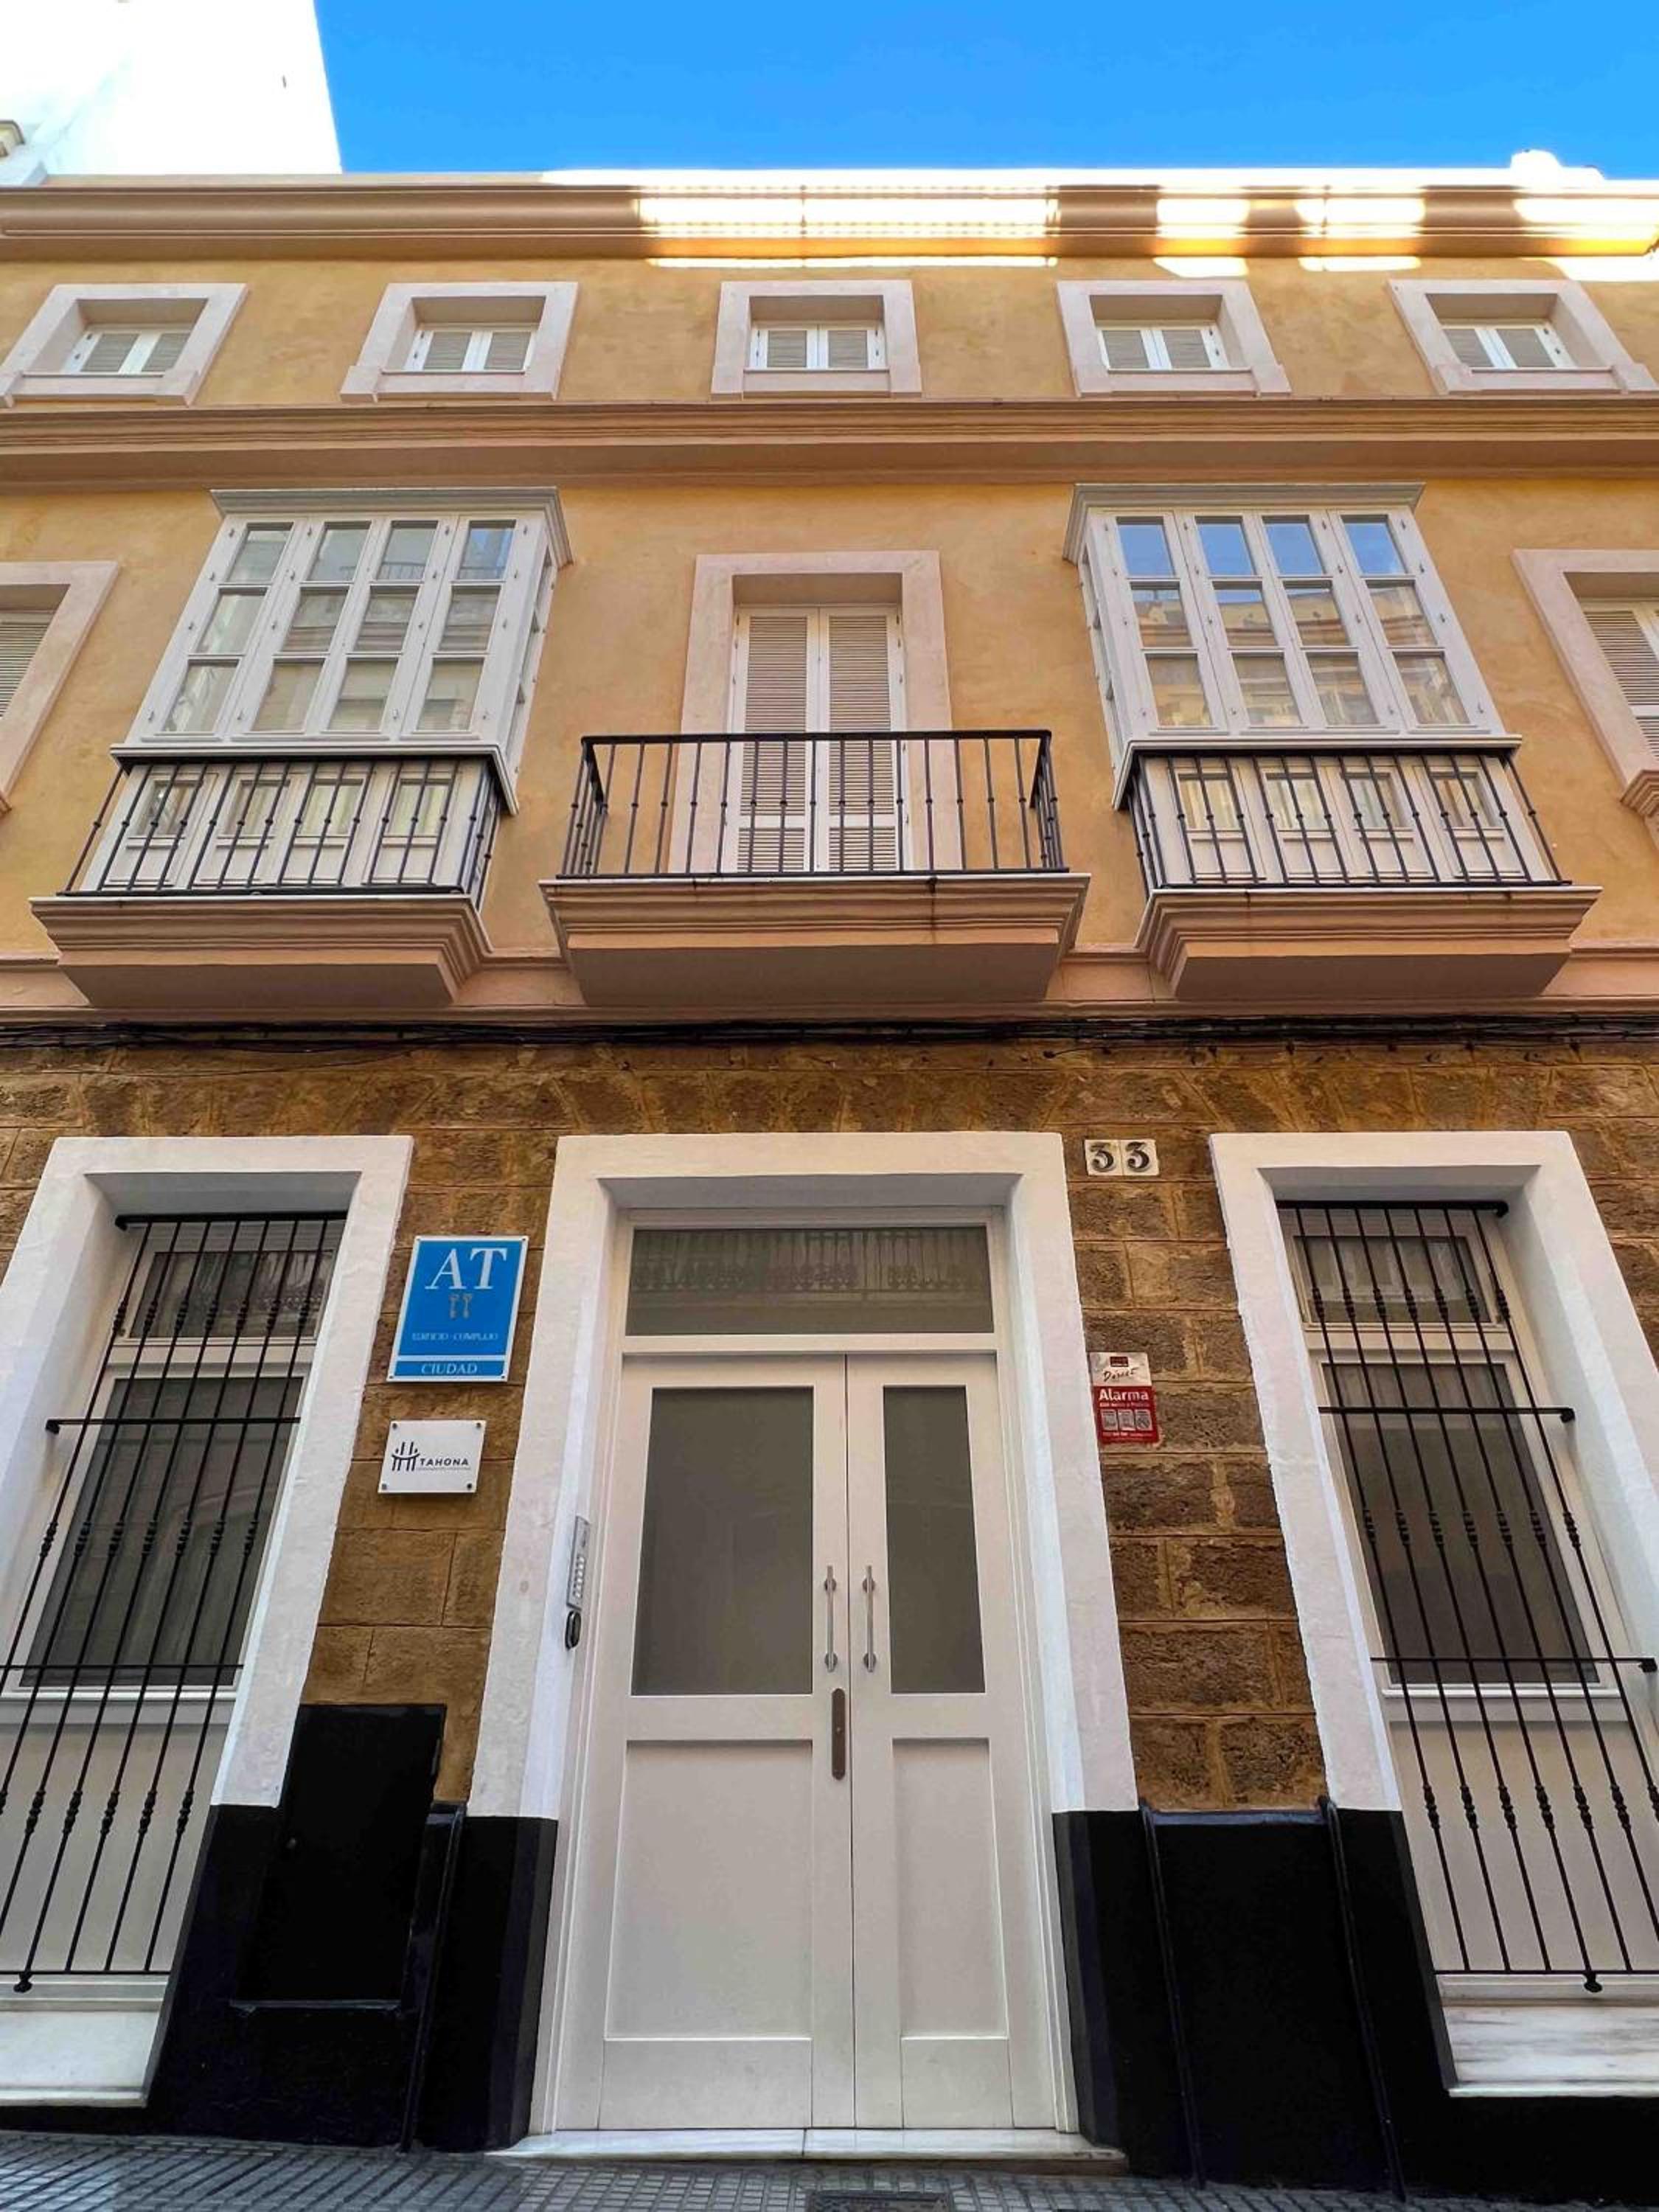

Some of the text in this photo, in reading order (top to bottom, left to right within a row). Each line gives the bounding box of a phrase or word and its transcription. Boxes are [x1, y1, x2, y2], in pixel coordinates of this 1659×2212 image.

[1089, 1141, 1150, 1172] 33
[424, 1248, 507, 1290] AT
[421, 1363, 478, 1374] CIUDAD
[1099, 1388, 1149, 1401] Alarma
[420, 1458, 470, 1466] TAHONA
